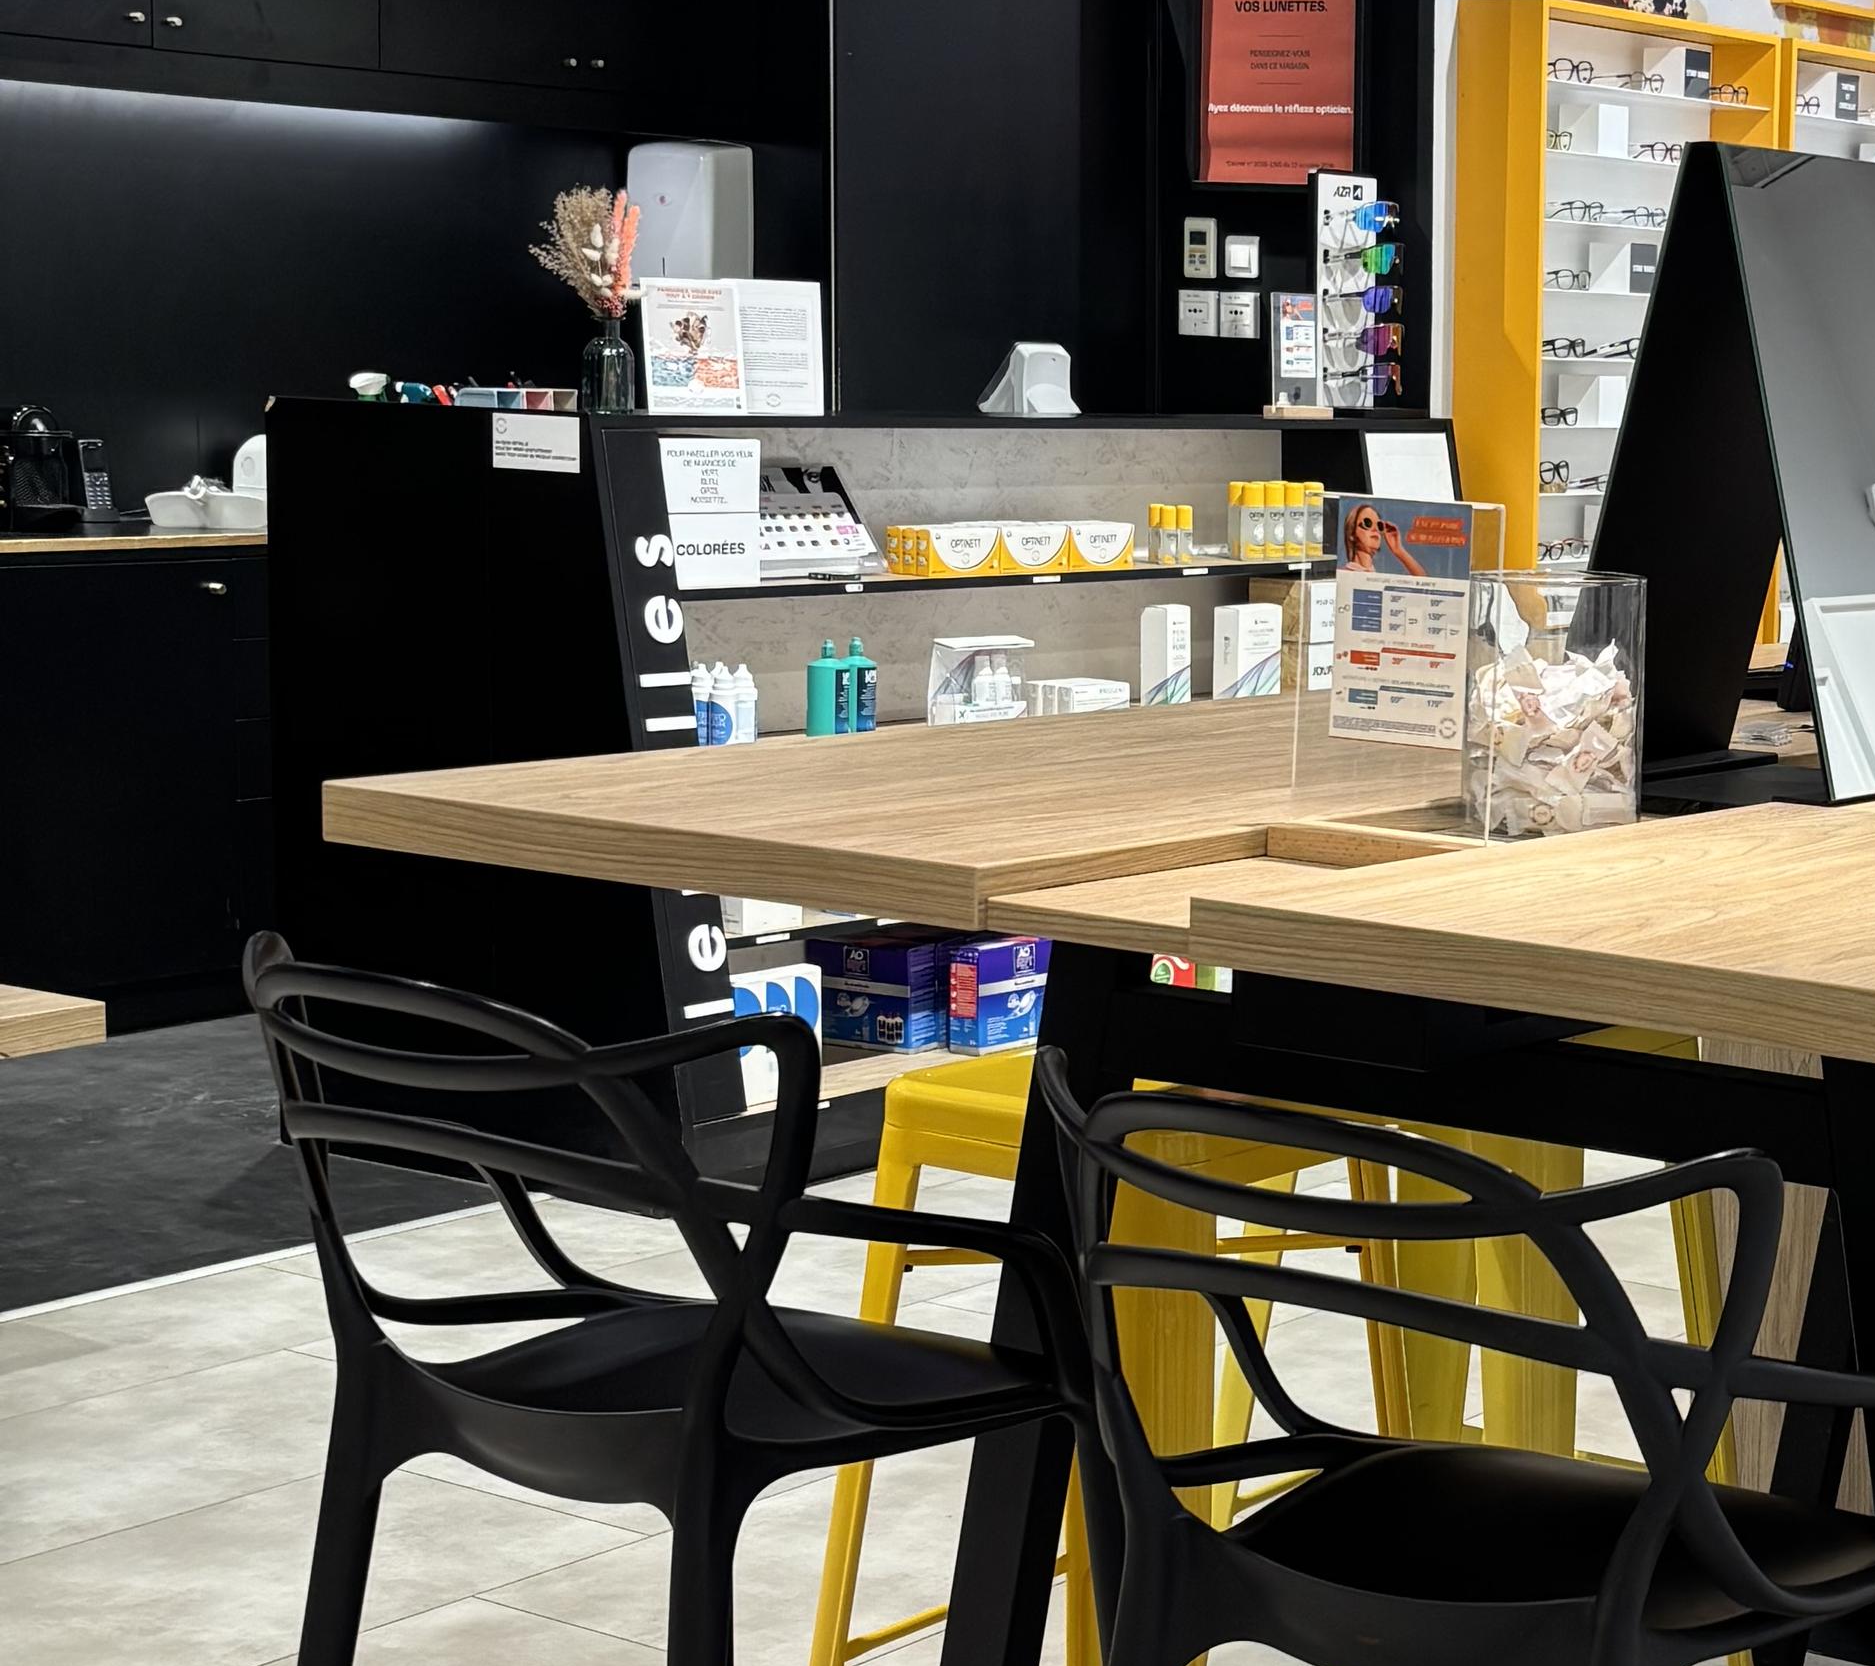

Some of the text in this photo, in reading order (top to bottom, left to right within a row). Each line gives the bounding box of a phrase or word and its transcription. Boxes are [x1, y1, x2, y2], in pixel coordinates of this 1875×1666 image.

[1235, 0, 1327, 12] VOS LUNETTES.
[676, 539, 746, 556] COLORÉES
